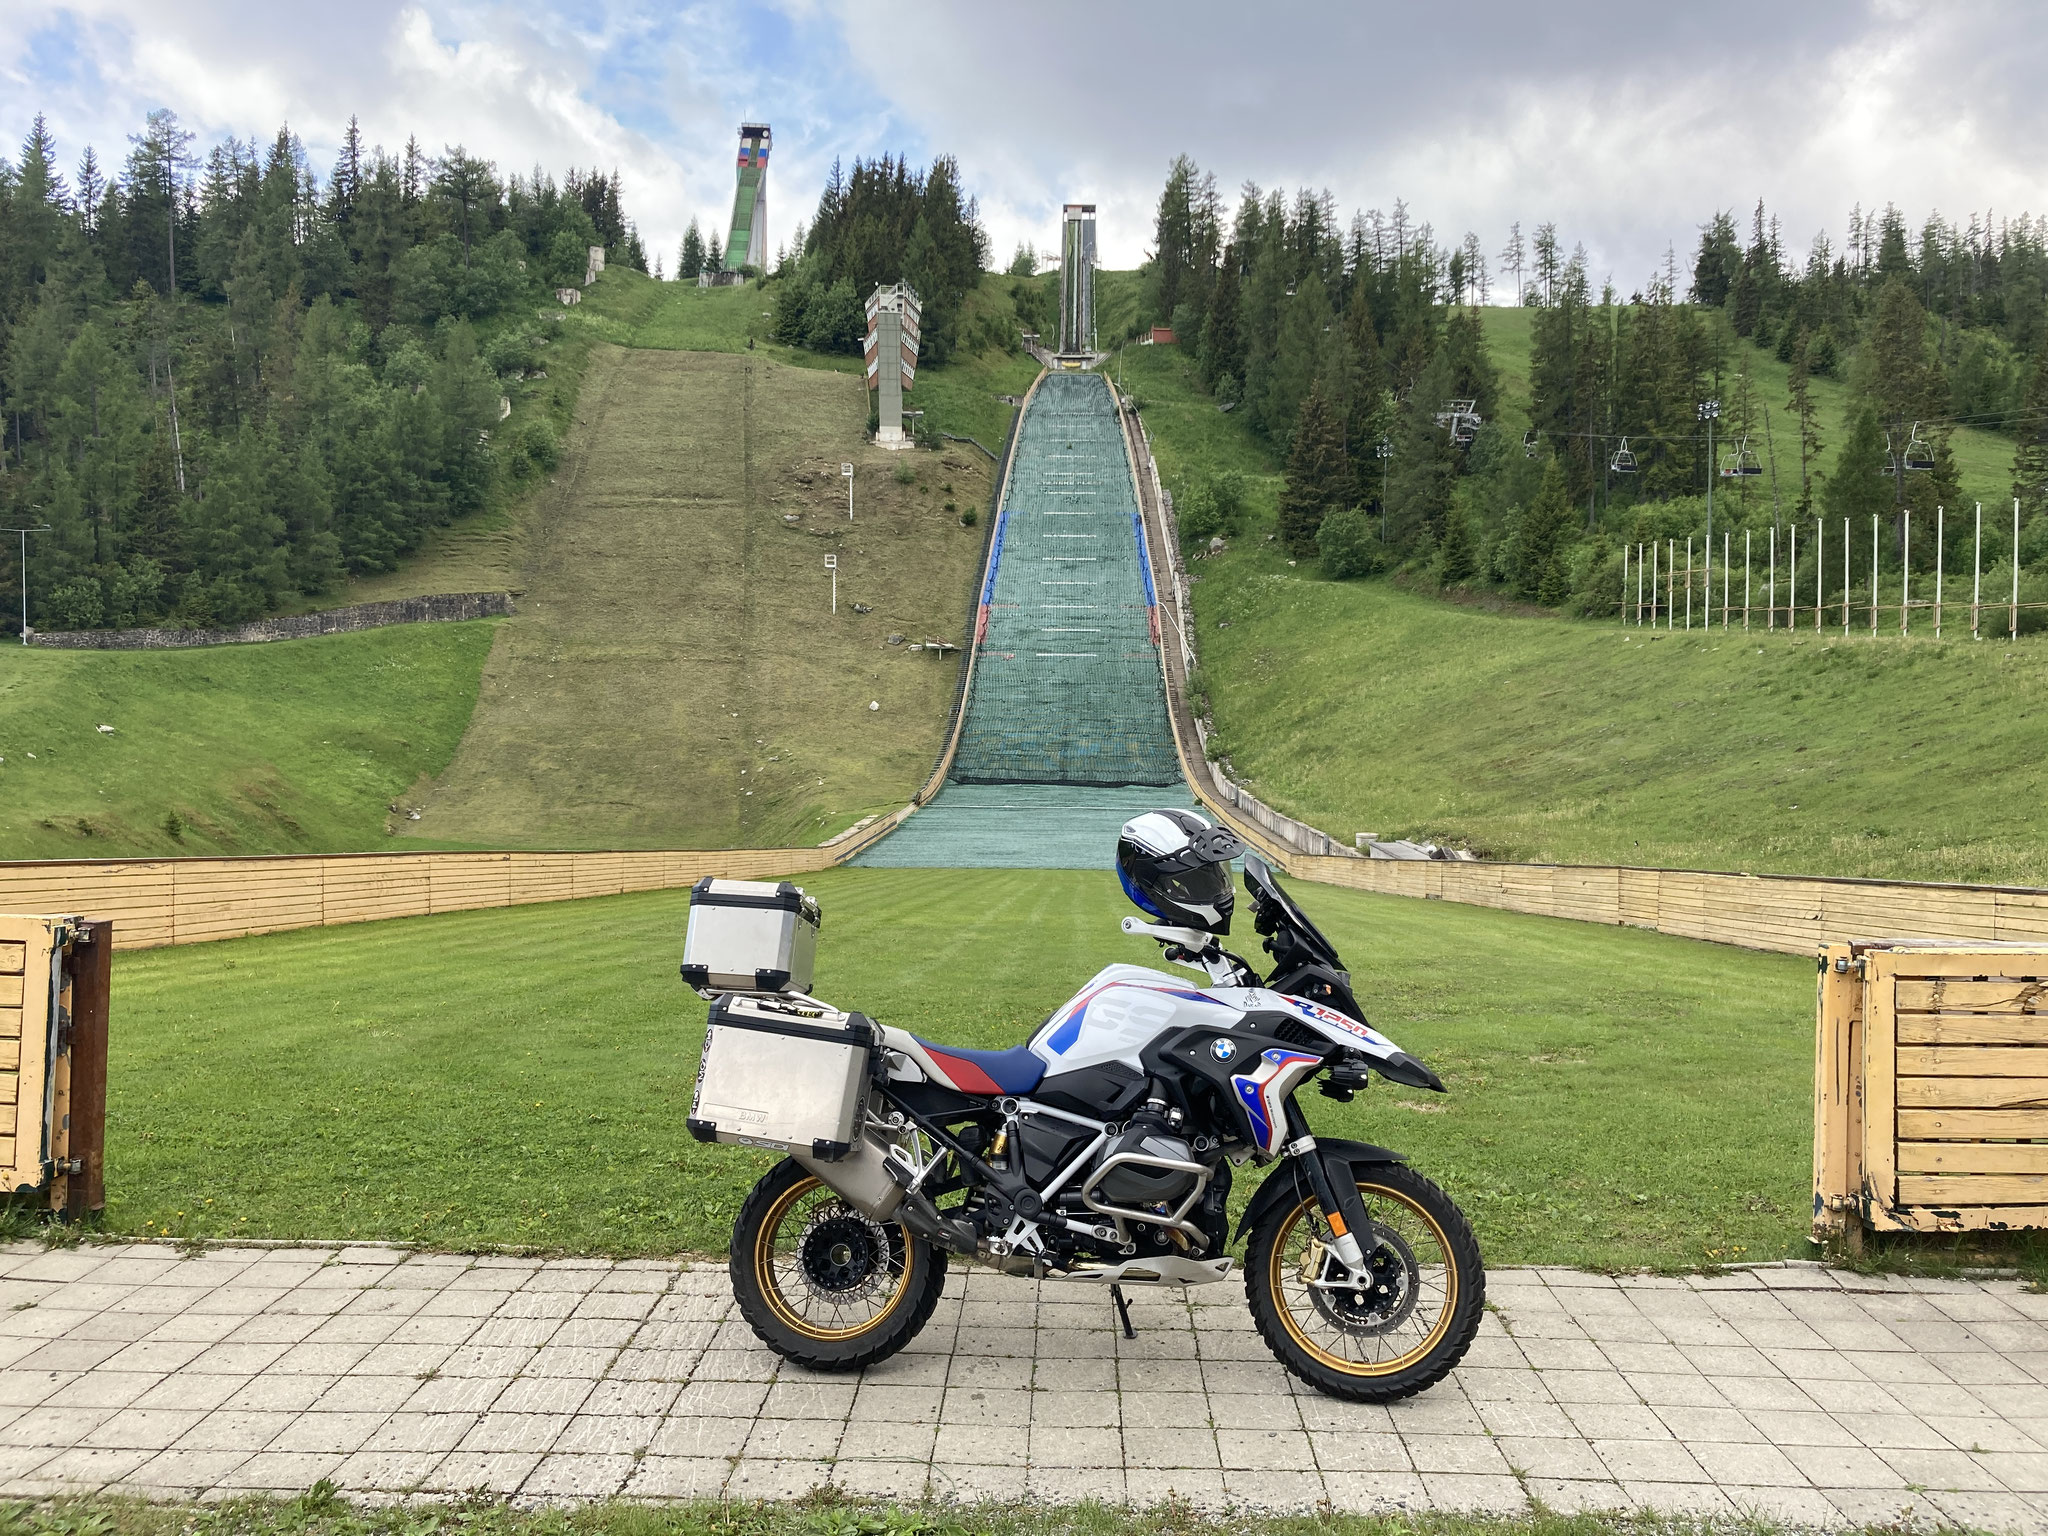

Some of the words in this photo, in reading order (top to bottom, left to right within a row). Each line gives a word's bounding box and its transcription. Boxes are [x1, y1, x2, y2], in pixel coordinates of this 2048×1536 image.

[1293, 1000, 1316, 1017] R
[1316, 1007, 1368, 1036] 1250
[739, 1111, 766, 1123] BMW
